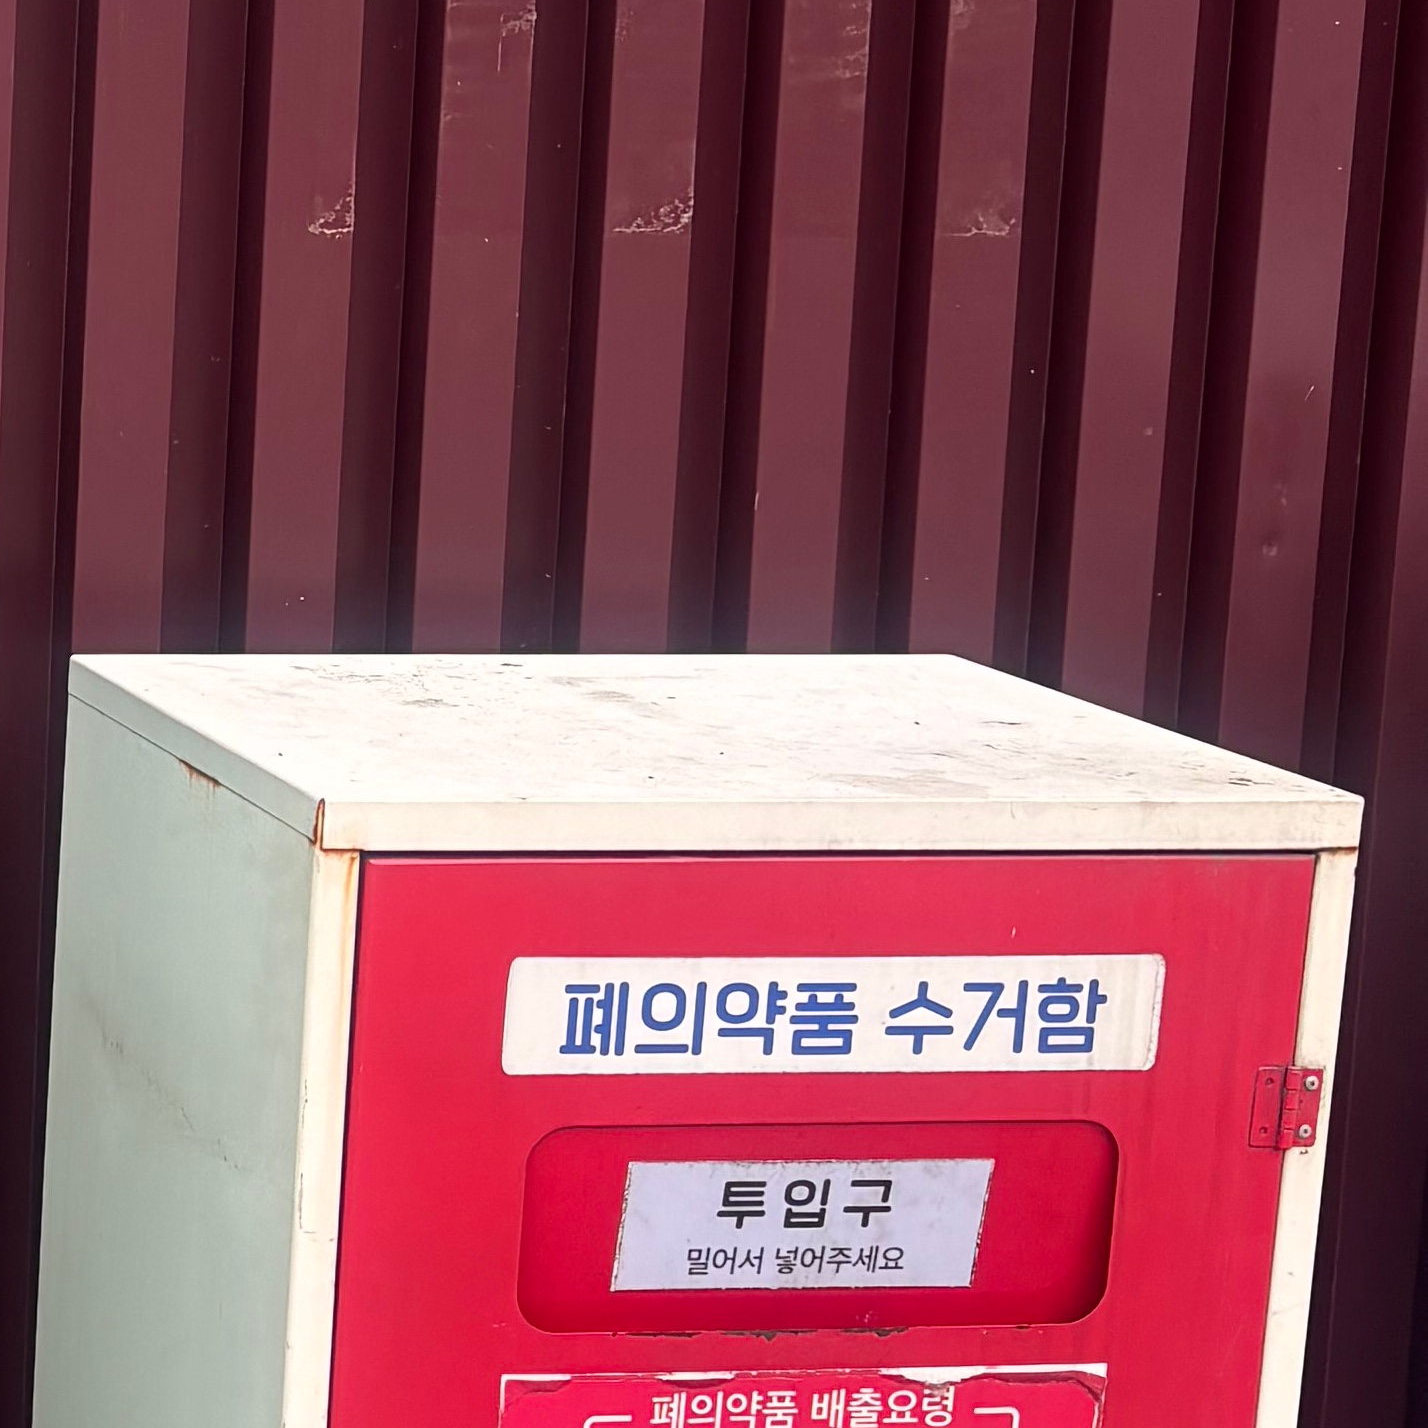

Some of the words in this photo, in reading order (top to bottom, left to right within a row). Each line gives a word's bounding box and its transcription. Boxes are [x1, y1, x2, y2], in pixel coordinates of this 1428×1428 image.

[560, 981, 859, 1056] 폐의약품
[885, 976, 1106, 1056] 수거함
[716, 1179, 894, 1230] 투입구
[686, 1246, 765, 1275] 밀어서
[775, 1245, 905, 1274] 넣어주세요
[810, 1388, 956, 1428] 배출요령
